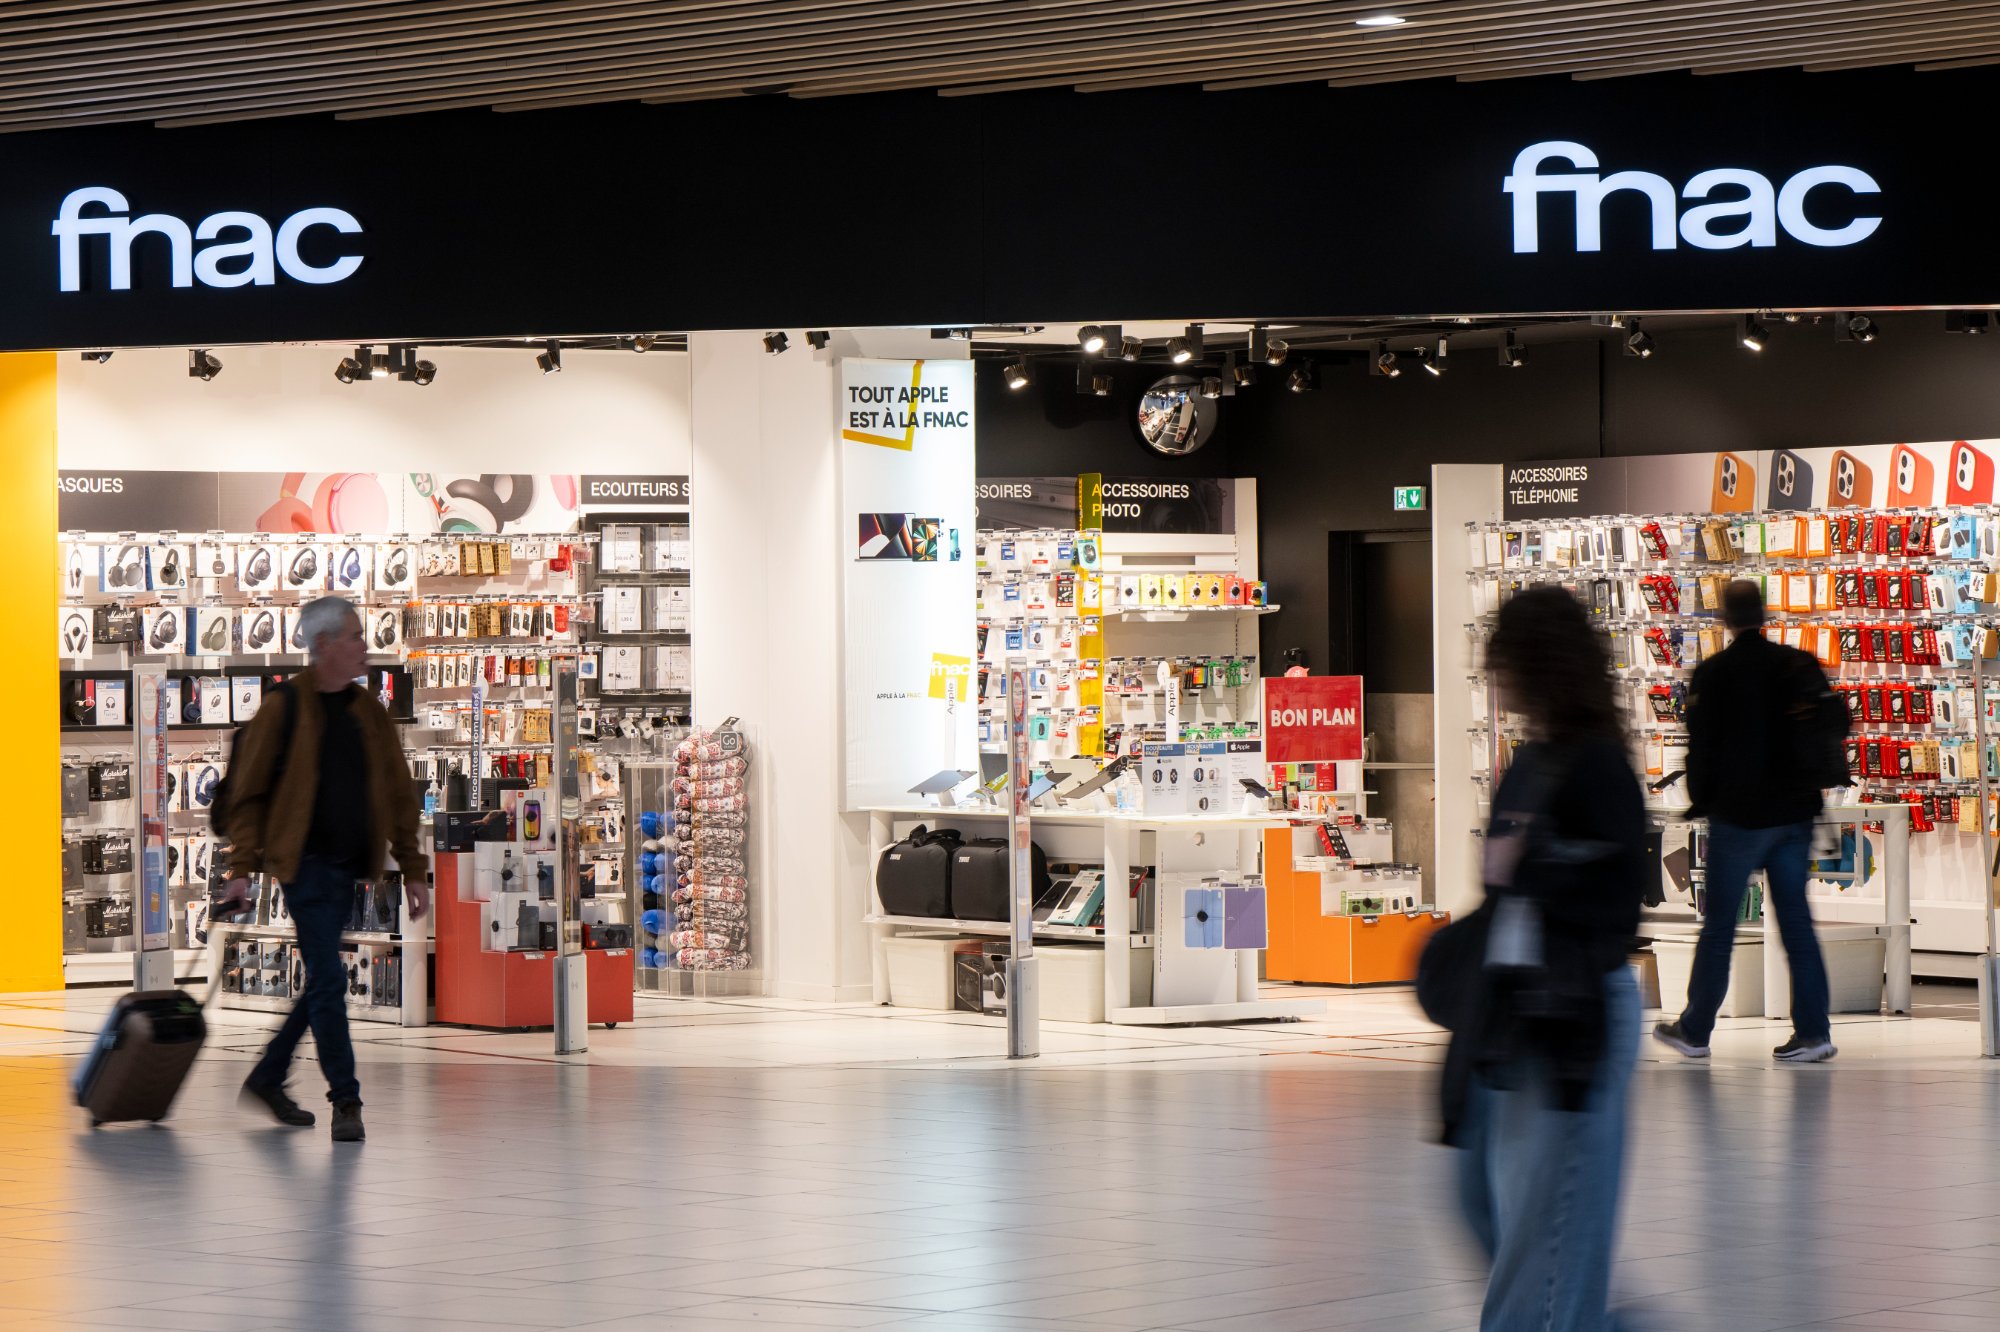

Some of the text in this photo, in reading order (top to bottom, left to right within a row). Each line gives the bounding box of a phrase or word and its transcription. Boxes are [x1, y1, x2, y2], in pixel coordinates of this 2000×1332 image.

[1502, 140, 1884, 253] fnac
[51, 186, 365, 292] fnac
[849, 386, 949, 403] TOUT APPLE
[849, 407, 969, 428] EST À LA FNAC
[1509, 465, 1588, 484] ACCESSOIRES
[591, 481, 679, 497] ECOUTEURS
[1091, 483, 1190, 499] ACCESSOIRES
[1509, 486, 1579, 505] TÉLÉPHONIE
[1091, 503, 1141, 518] PHOTO
[946, 682, 954, 715] Apple
[1167, 681, 1176, 716] Apple
[1270, 707, 1356, 728] BON PLAN
[722, 734, 736, 746] Go
[1236, 742, 1251, 750] Apple
